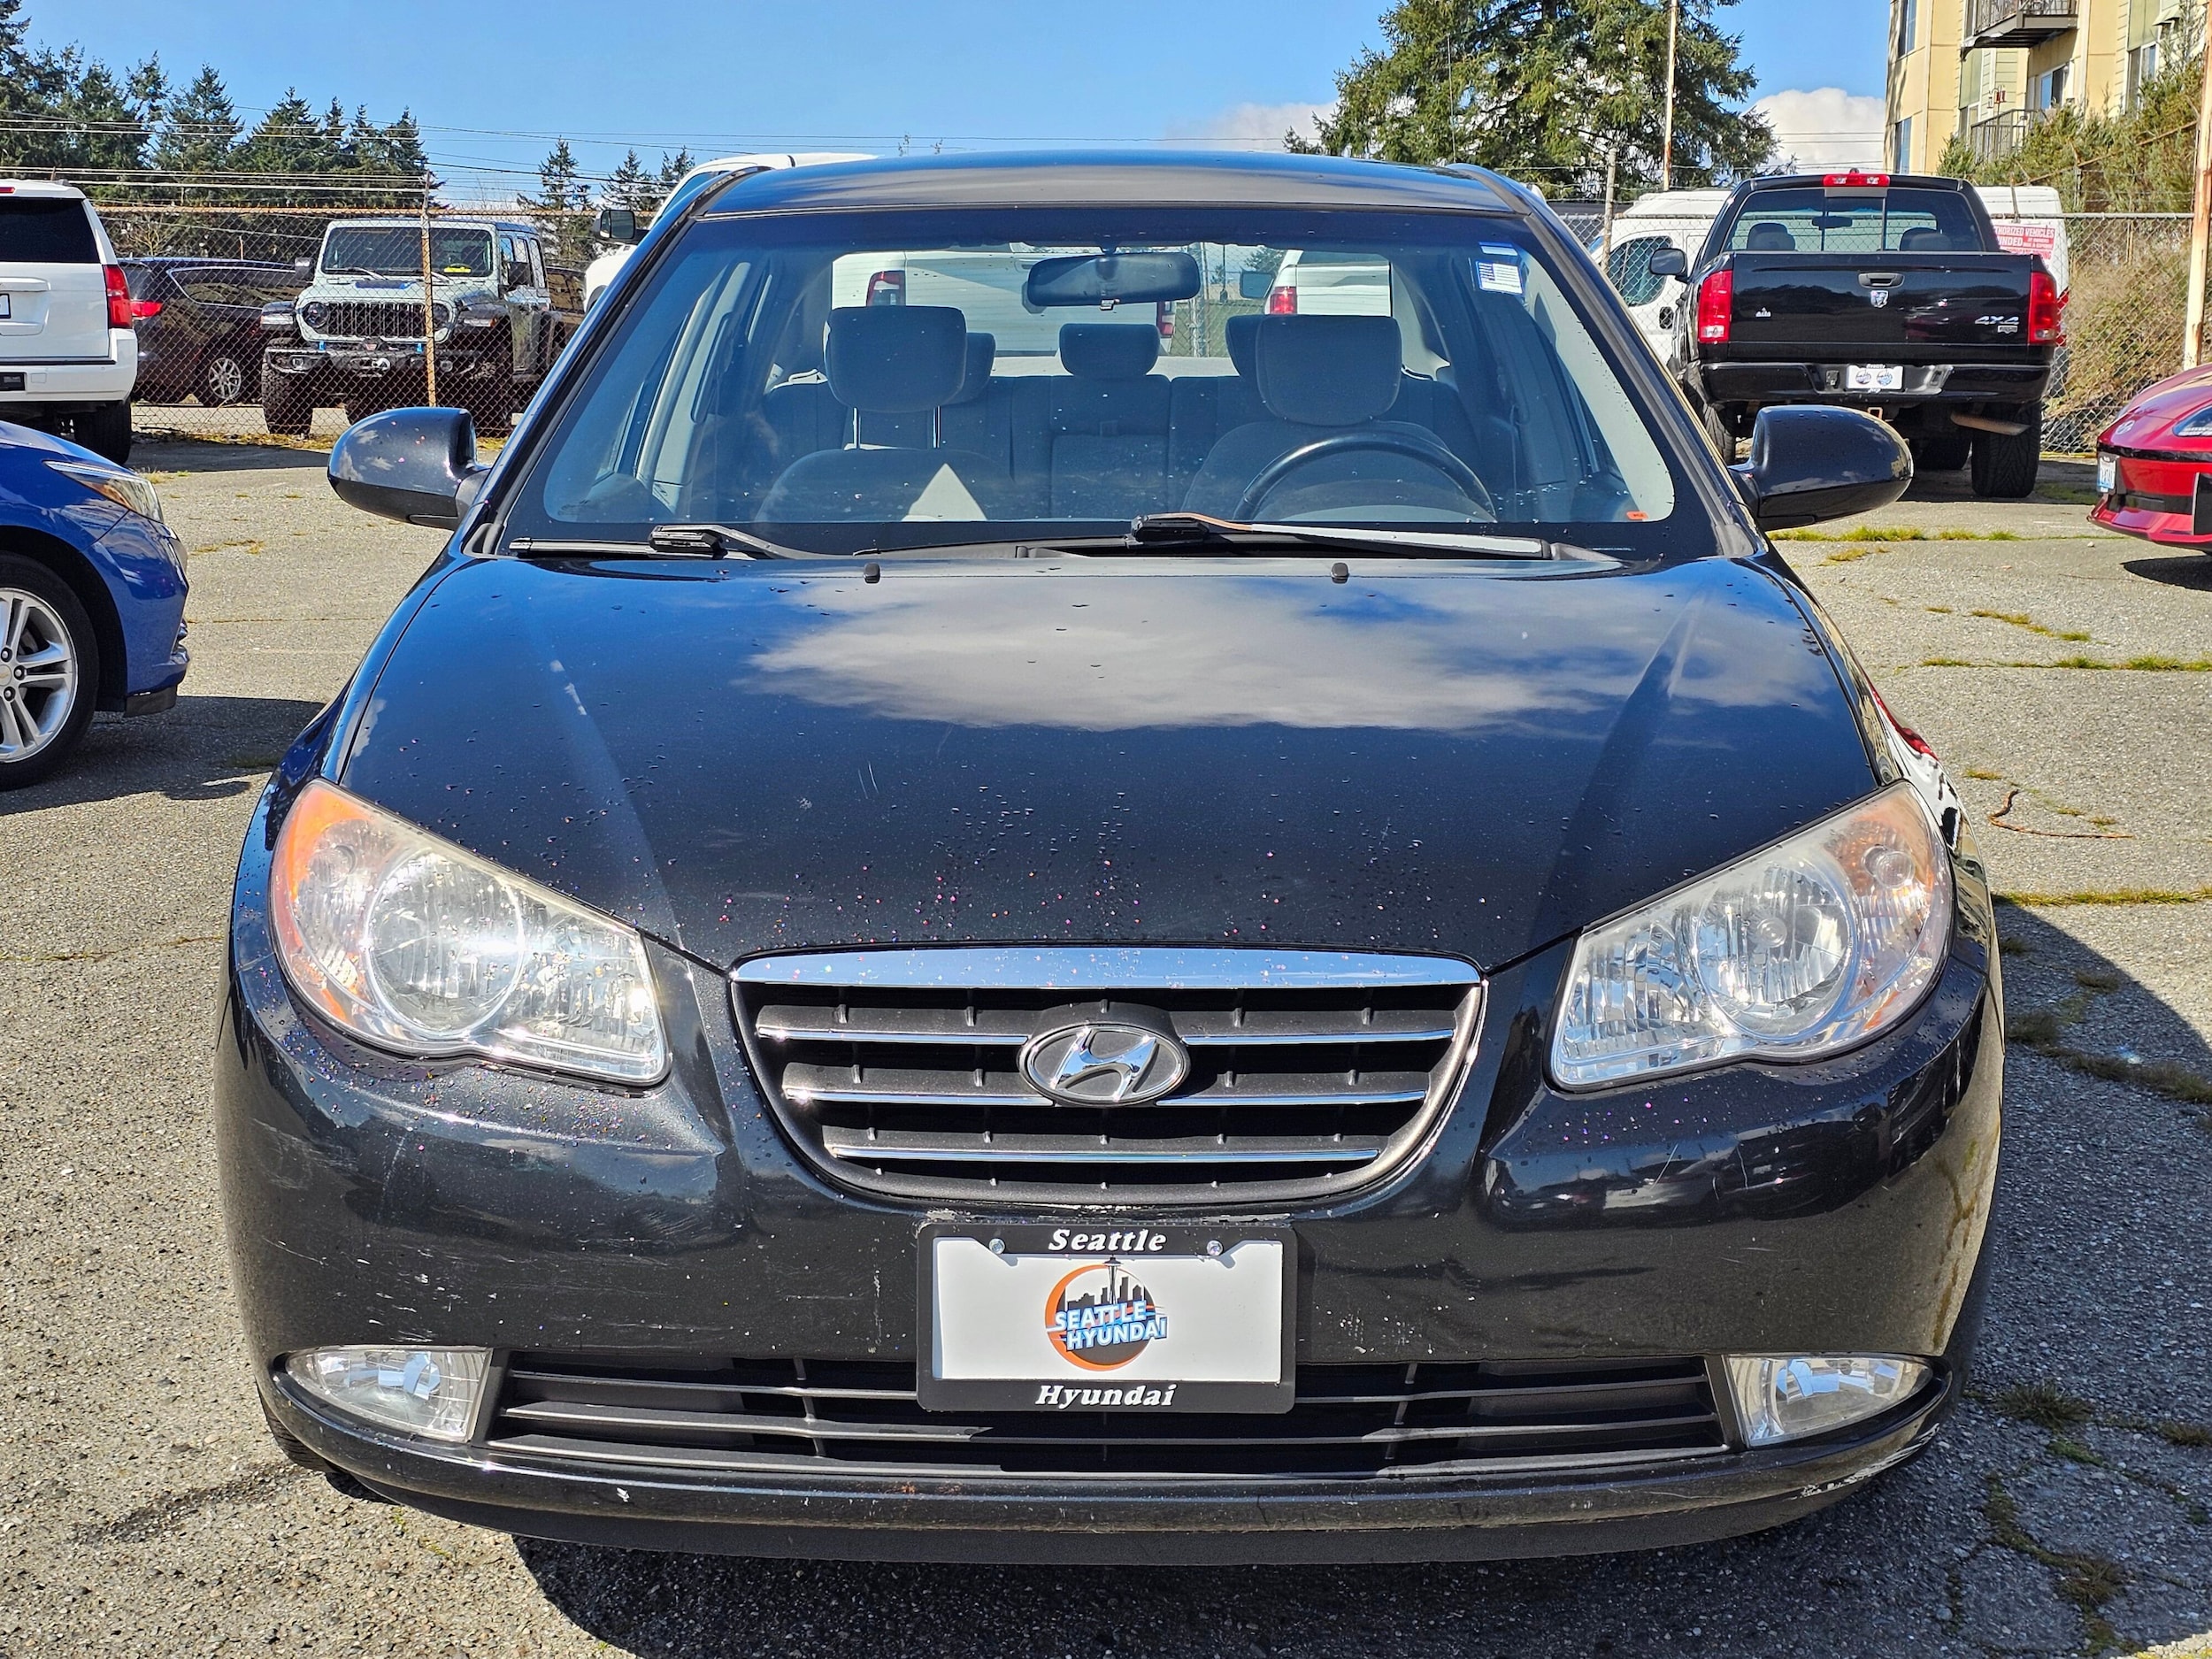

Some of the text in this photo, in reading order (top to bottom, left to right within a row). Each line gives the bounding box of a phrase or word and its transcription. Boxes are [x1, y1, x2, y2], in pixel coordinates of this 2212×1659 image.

[1048, 1228, 1166, 1251] Seattle
[1054, 1300, 1147, 1331] SEATTLE
[1066, 1317, 1167, 1351] HYUNDAI
[1034, 1384, 1177, 1409] Hyundai
